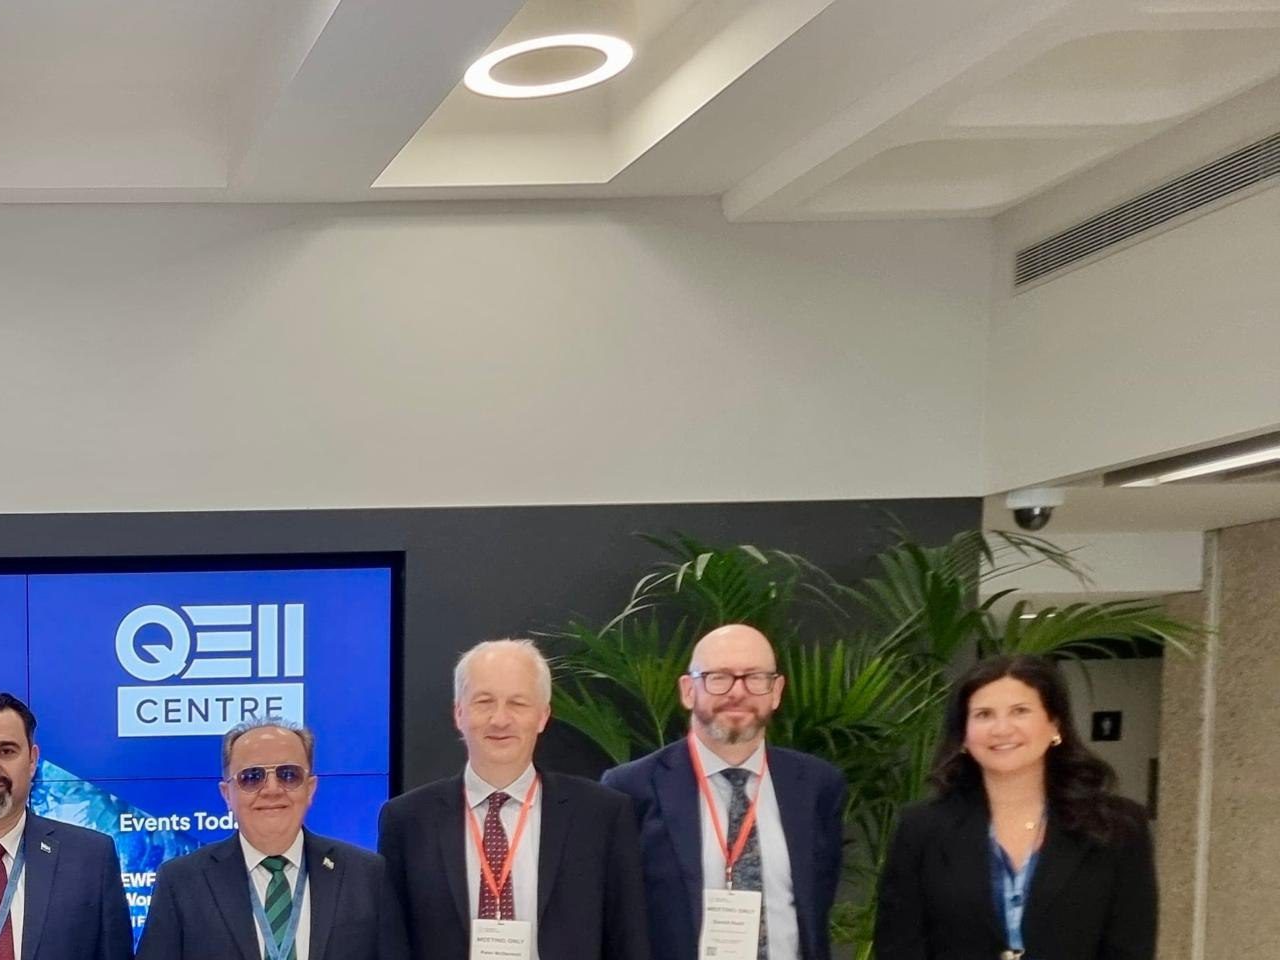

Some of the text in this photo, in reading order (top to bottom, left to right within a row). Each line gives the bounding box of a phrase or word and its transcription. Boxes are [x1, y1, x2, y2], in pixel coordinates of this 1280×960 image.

[136, 696, 283, 724] CENTRE
[120, 811, 239, 832] Events Tod
